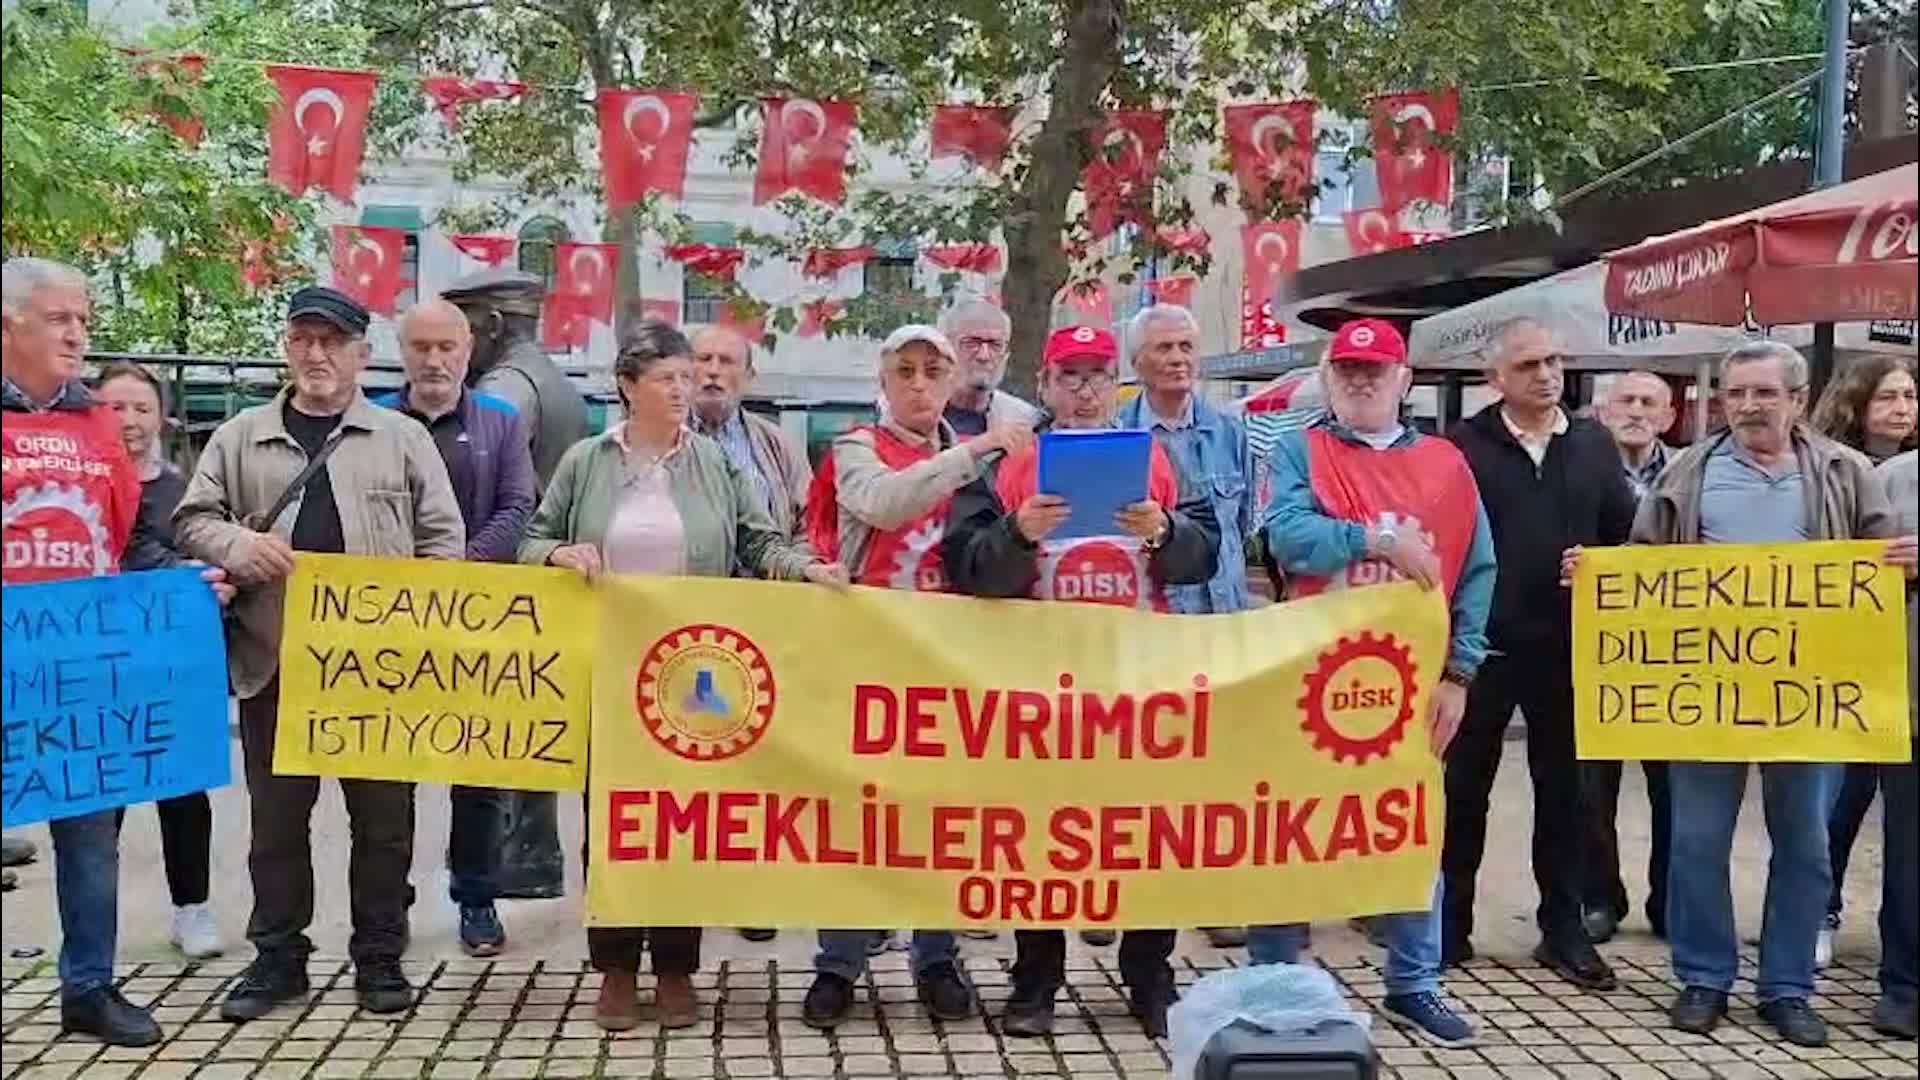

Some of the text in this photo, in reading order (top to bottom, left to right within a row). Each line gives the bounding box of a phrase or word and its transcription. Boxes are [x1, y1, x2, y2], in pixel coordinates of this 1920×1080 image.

[14, 435, 77, 454] ORDU
[3, 527, 93, 569] DİSK
[310, 574, 542, 636] İNSANCA
[1057, 560, 1134, 599] DİSK
[1594, 555, 1885, 613] EMEKLİLER
[306, 644, 566, 701] YAŞAMAK
[1330, 679, 1395, 711] DİSK
[3, 697, 176, 763] EKLİYE
[307, 707, 574, 765] İSTİYORUZ
[852, 672, 1211, 760] DEVRİMCİ
[607, 780, 1428, 873] EMEKLİLER SENDİKASI
[957, 875, 1120, 923] ORDU
